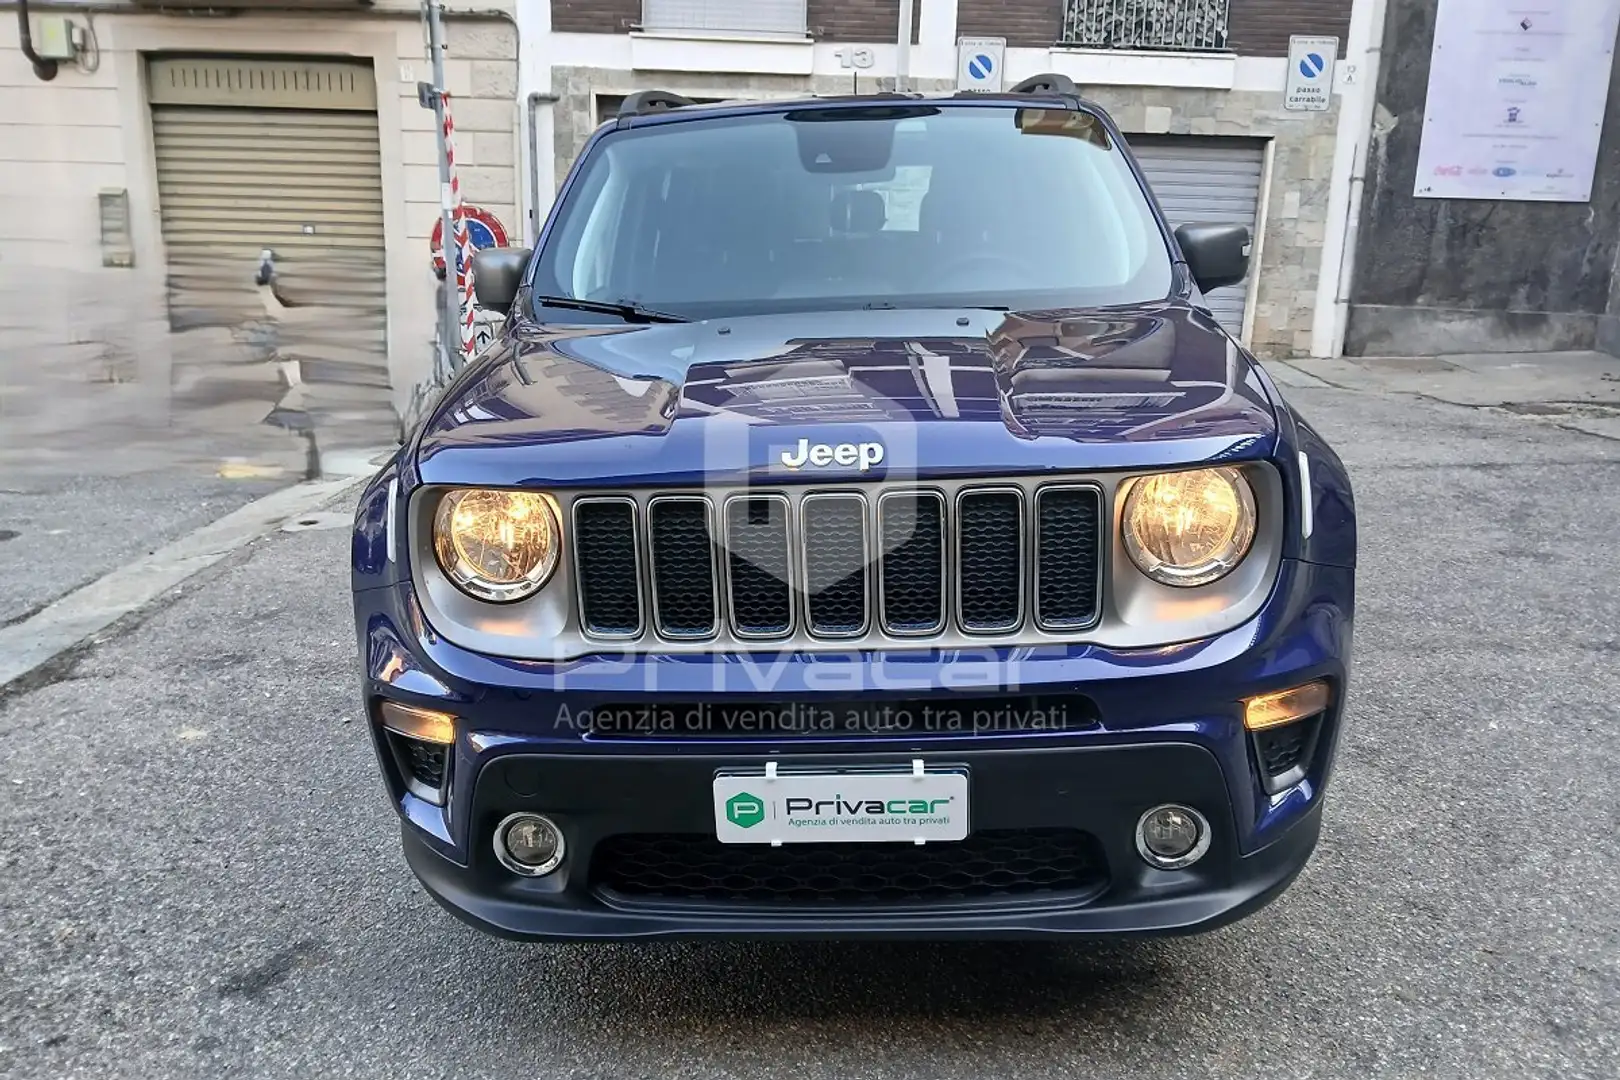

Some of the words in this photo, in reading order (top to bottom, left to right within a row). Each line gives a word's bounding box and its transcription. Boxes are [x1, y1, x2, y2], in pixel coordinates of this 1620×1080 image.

[834, 47, 875, 69] 13
[1296, 86, 1321, 94] passo
[1289, 95, 1326, 104] carrabile
[781, 438, 885, 471] Jeep
[785, 793, 950, 816] Privacar
[788, 816, 827, 827] Agenzia
[829, 815, 839, 826] di
[840, 816, 878, 826] vendita
[879, 816, 902, 826] auto
[903, 816, 918, 826] tra
[919, 815, 950, 826] privati
